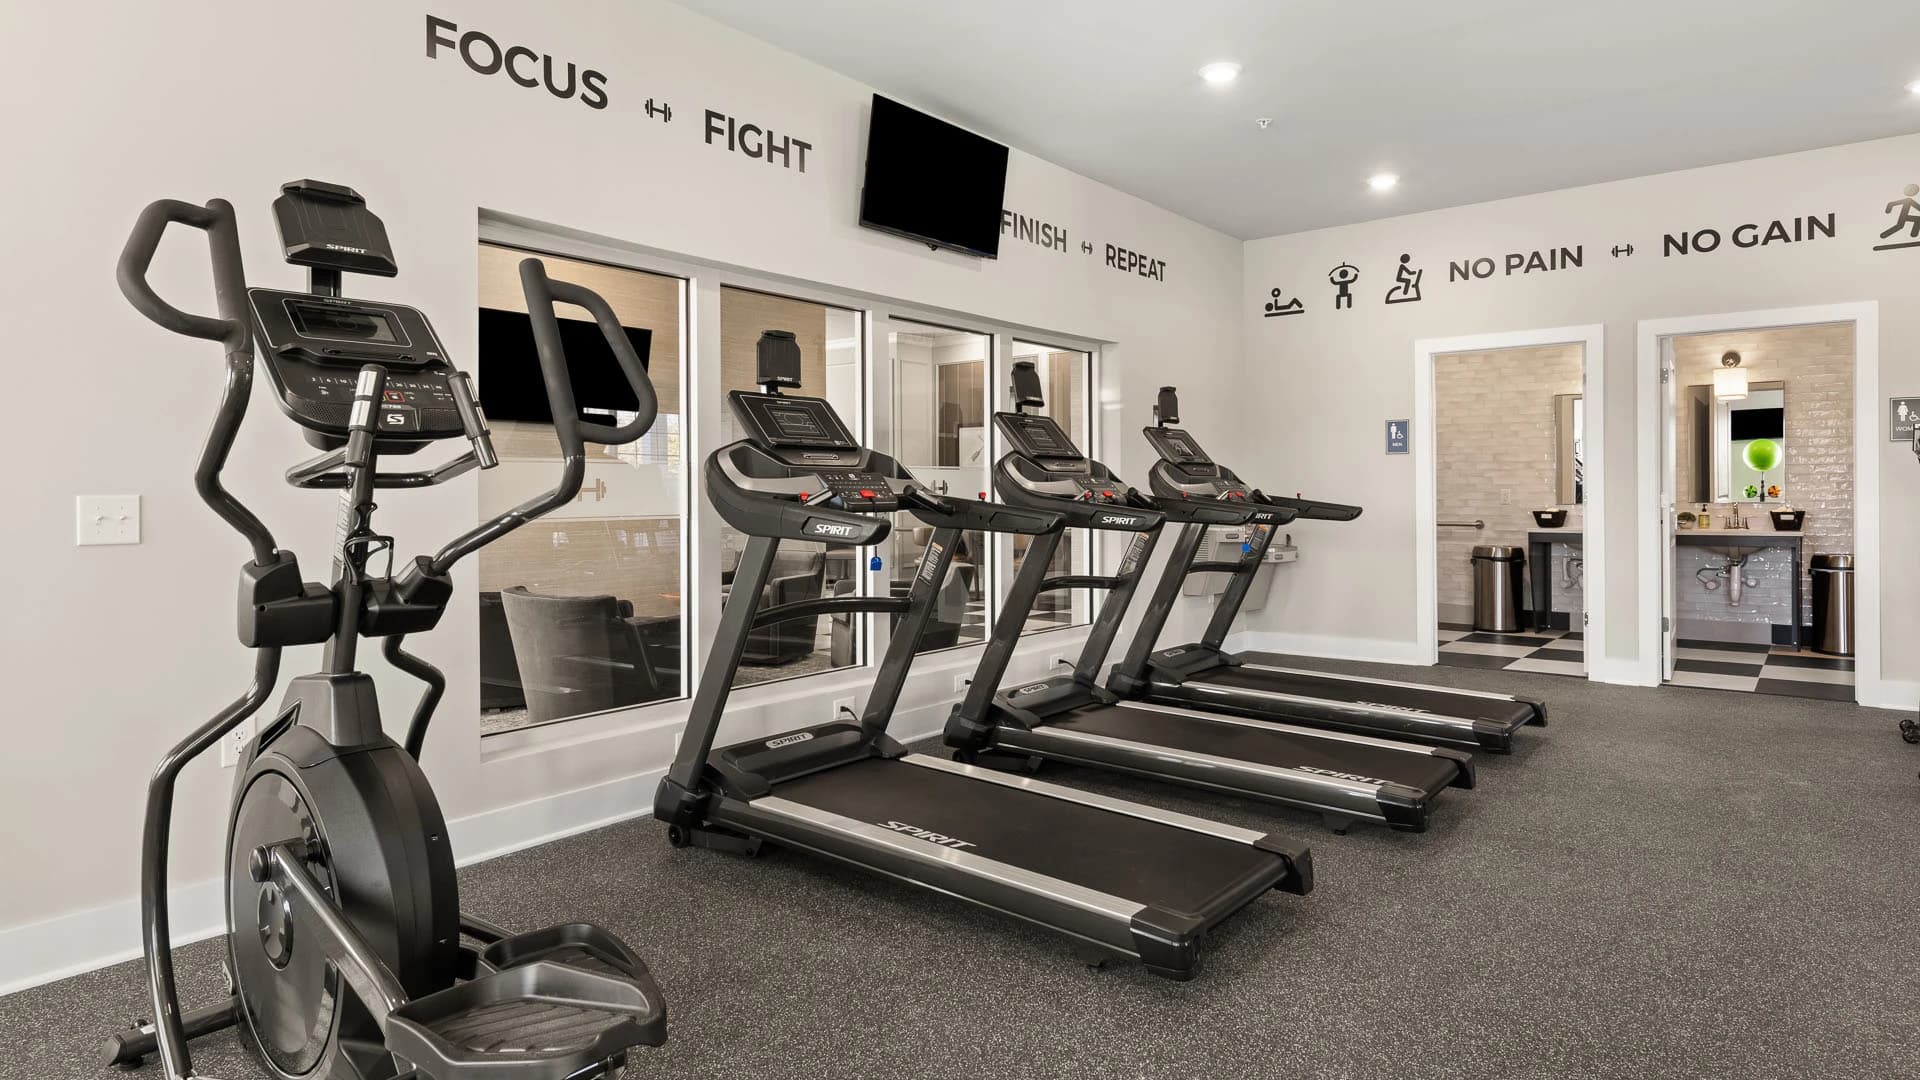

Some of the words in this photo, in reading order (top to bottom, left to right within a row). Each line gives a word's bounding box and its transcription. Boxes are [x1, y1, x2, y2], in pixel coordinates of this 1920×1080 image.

[425, 14, 609, 110] FOCUS
[704, 108, 813, 174] FIGHT
[1001, 209, 1067, 253] FINISH
[1105, 242, 1168, 283] REPEAT
[326, 244, 367, 254] SPIRIT
[1449, 257, 1496, 283] NO
[1505, 244, 1583, 276] PAIN
[1663, 228, 1722, 258] NO
[1731, 212, 1837, 249] GAIN
[1101, 515, 1137, 525] SPIRIT
[1255, 512, 1274, 520] IRIT
[814, 523, 853, 536] SPIRIT
[772, 733, 807, 747] SPIRIT
[1292, 765, 1395, 786] SPIRIT
[877, 820, 977, 848] SPIRIT
